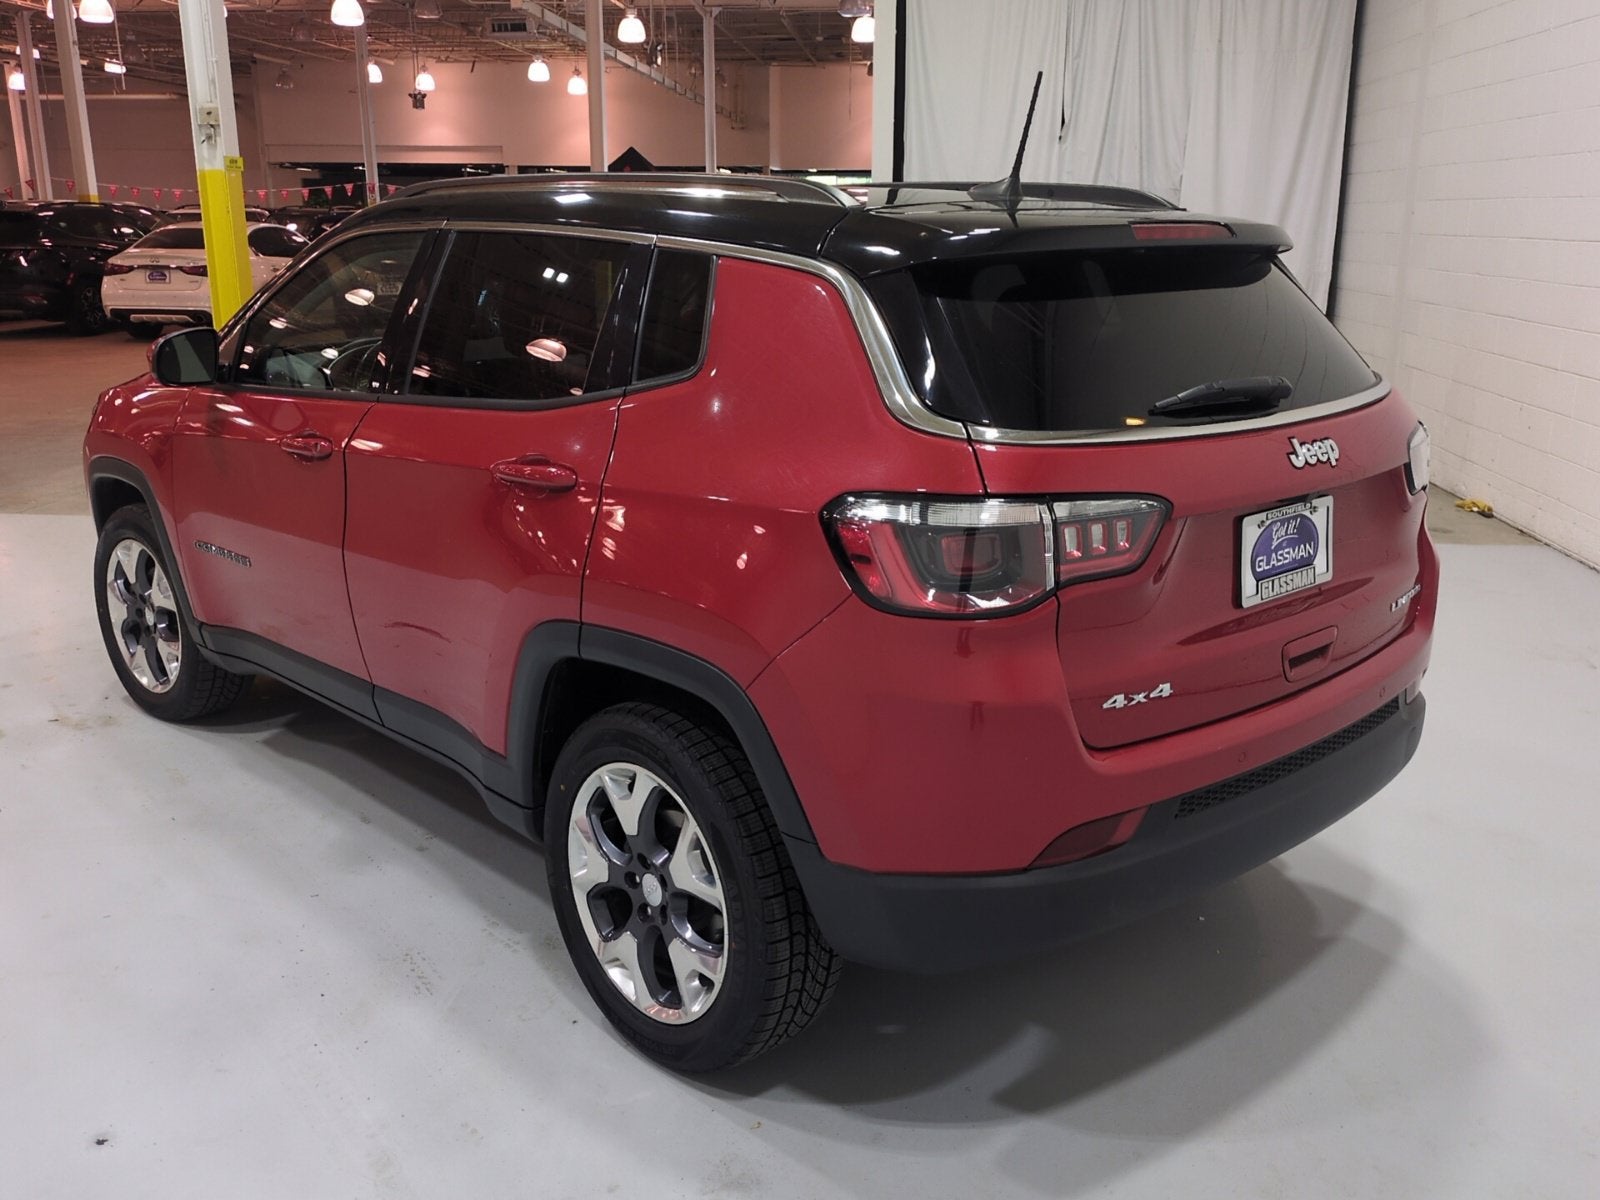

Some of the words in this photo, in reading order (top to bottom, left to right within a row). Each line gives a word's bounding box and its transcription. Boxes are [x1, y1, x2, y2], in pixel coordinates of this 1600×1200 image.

[1287, 437, 1340, 469] Jeep
[1267, 502, 1312, 520] SOUTHFIELD
[1287, 517, 1301, 534] it!
[1255, 541, 1314, 572] GLASSMAN
[1261, 566, 1316, 600] GLASSMAN
[1102, 682, 1174, 709] 4x4
